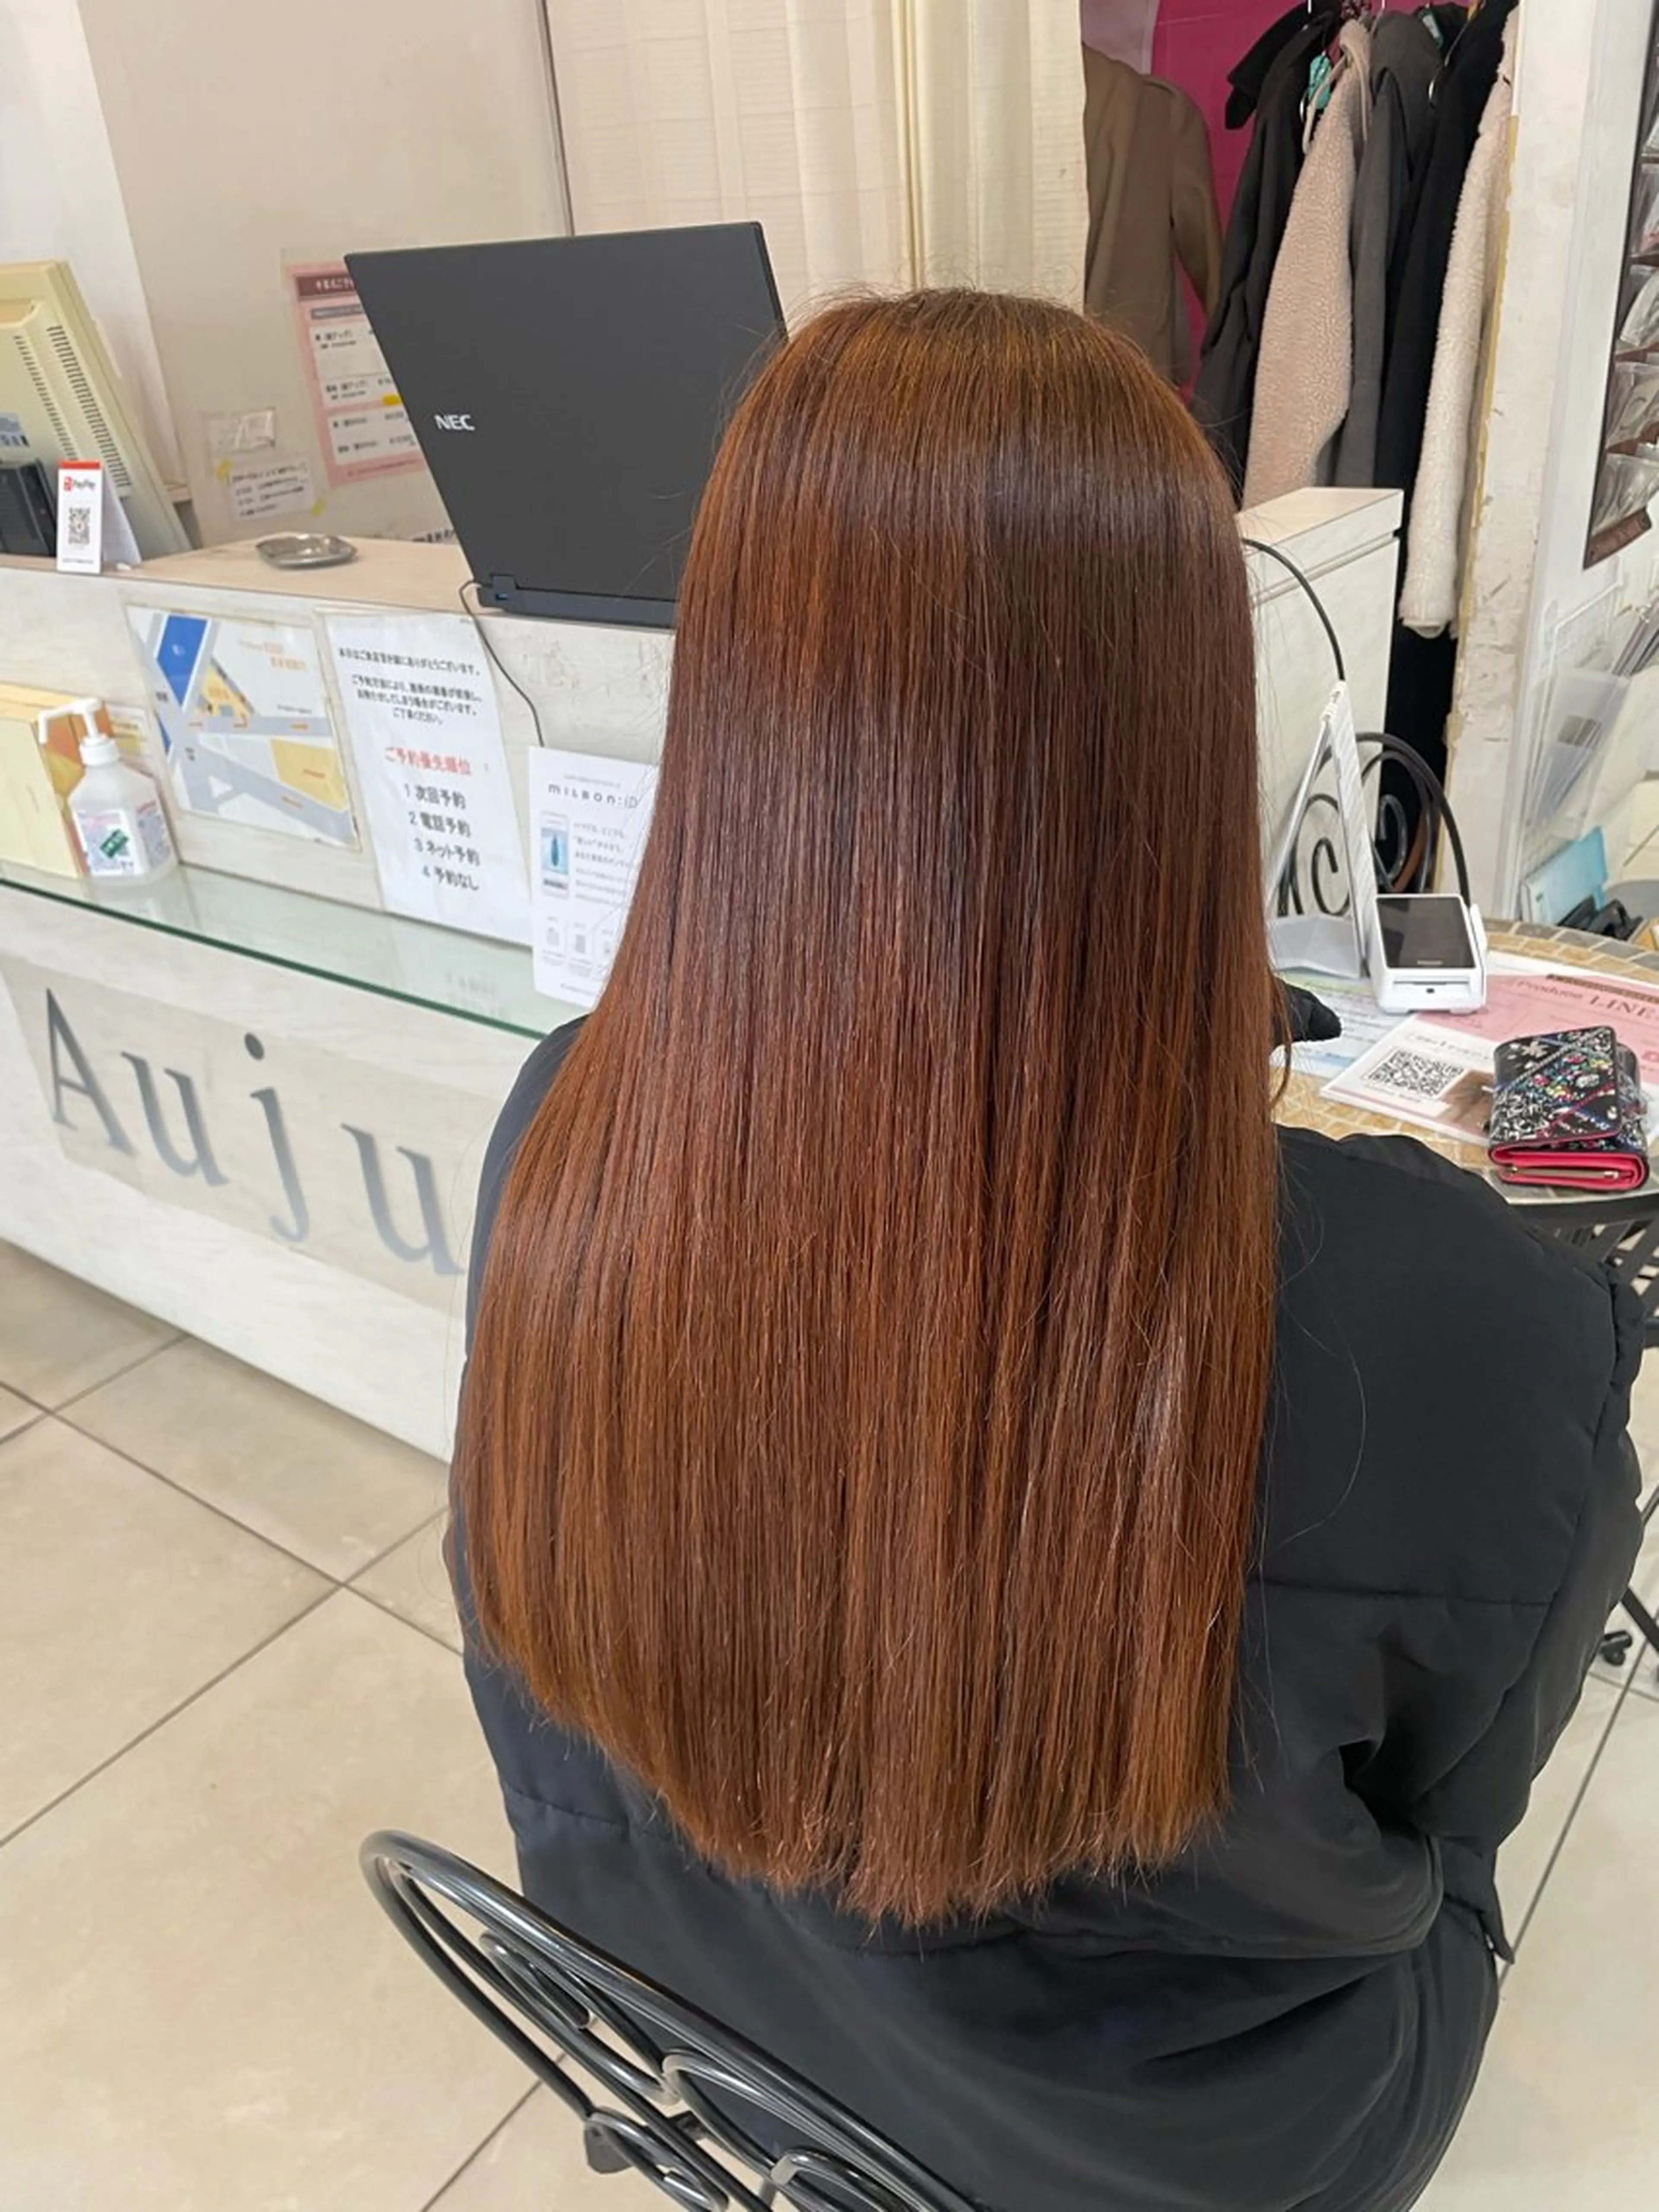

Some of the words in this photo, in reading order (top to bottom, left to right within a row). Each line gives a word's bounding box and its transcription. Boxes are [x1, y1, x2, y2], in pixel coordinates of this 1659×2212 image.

[434, 414, 475, 431] NEC
[385, 747, 471, 775] ご予約優先順位
[404, 783, 410, 798] 1
[414, 785, 466, 809] 次回予約
[409, 811, 417, 826] 2
[420, 811, 471, 837] 電話予約
[426, 841, 480, 867] ネット予約
[434, 866, 479, 891] 予約なし
